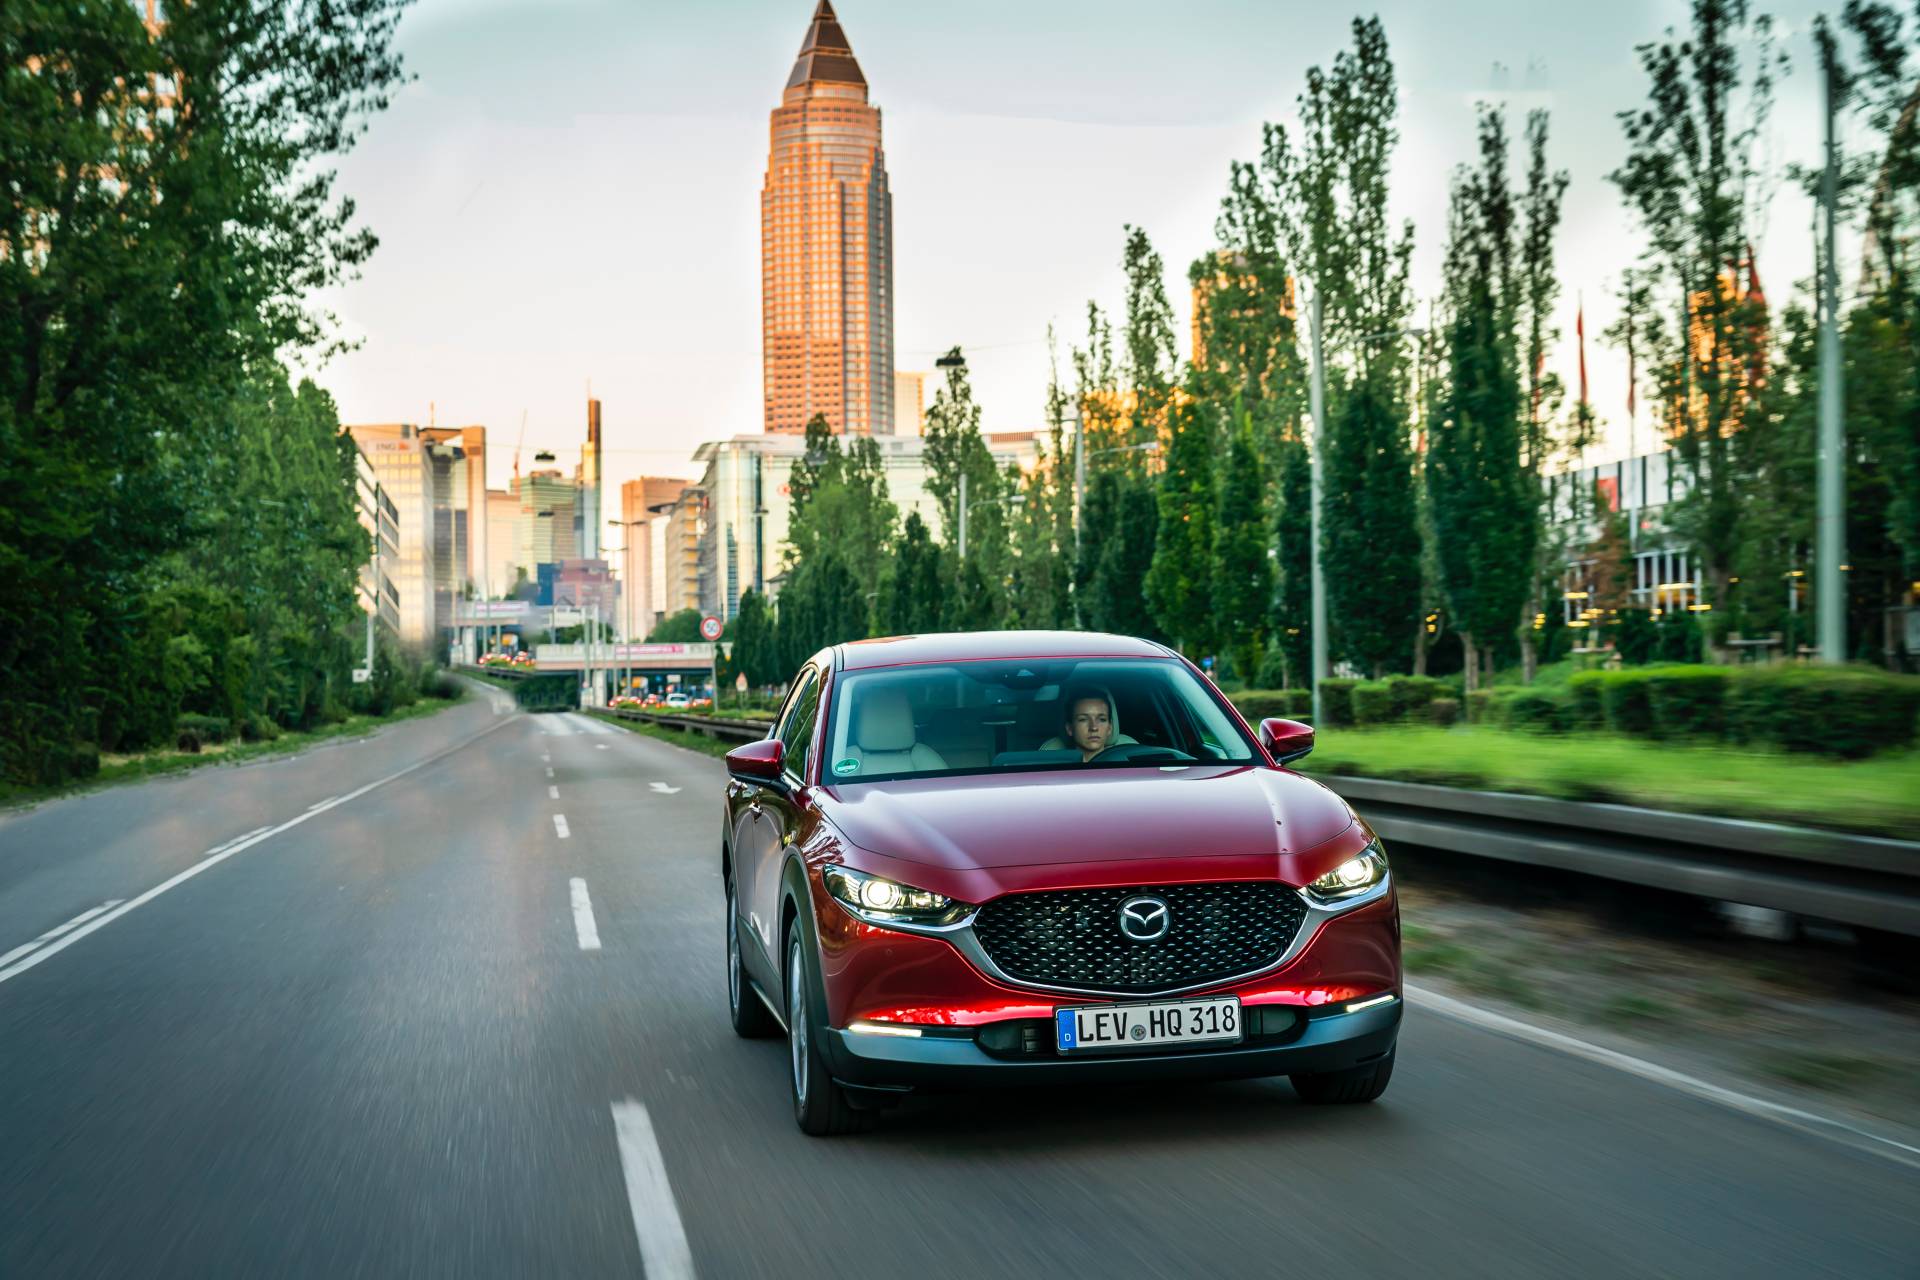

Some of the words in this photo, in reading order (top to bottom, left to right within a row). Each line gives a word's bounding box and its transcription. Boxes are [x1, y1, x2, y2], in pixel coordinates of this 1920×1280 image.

[1077, 1012, 1128, 1042] LEV
[1150, 1008, 1183, 1038] HQ
[1189, 1004, 1236, 1034] 318
[1064, 1033, 1071, 1042] D
